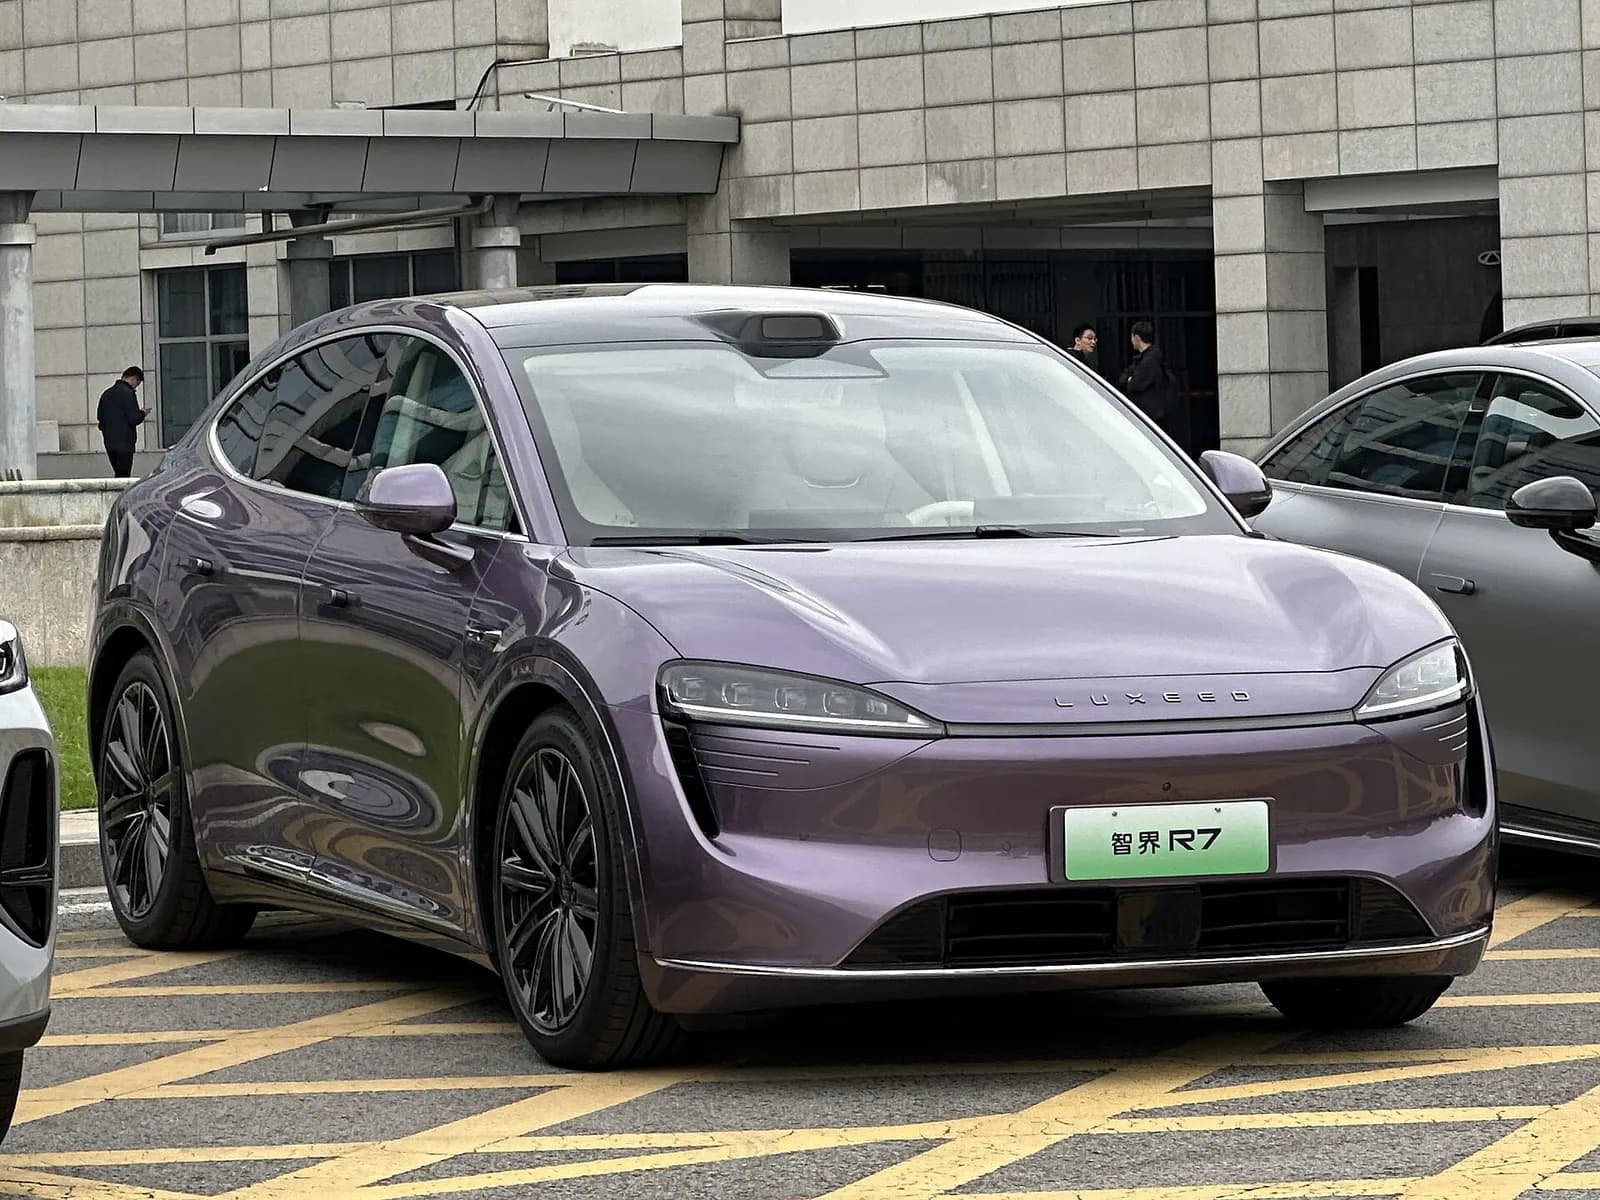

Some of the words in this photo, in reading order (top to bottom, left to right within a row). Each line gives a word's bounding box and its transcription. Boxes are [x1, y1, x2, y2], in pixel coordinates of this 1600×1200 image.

[1055, 691, 1251, 707] LUXEED
[1111, 830, 1160, 855] 智界
[1169, 828, 1222, 851] R7
